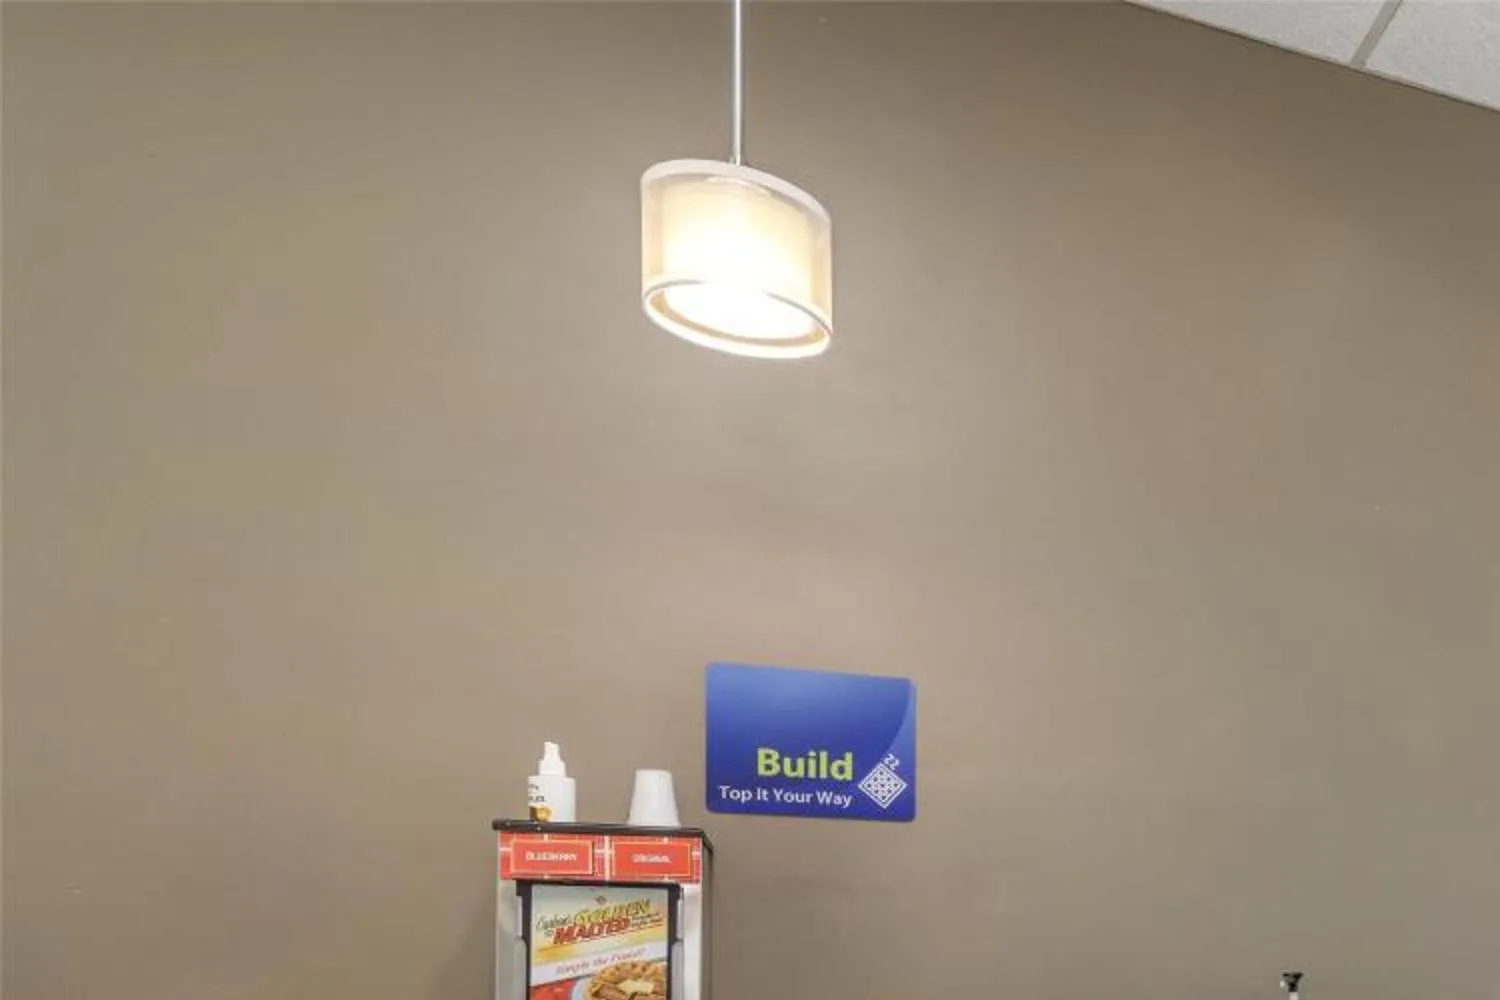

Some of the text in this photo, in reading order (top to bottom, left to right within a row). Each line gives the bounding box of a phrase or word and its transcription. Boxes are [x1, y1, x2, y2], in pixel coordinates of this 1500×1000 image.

[757, 747, 853, 780] Build
[719, 785, 852, 808] Top It Your Way
